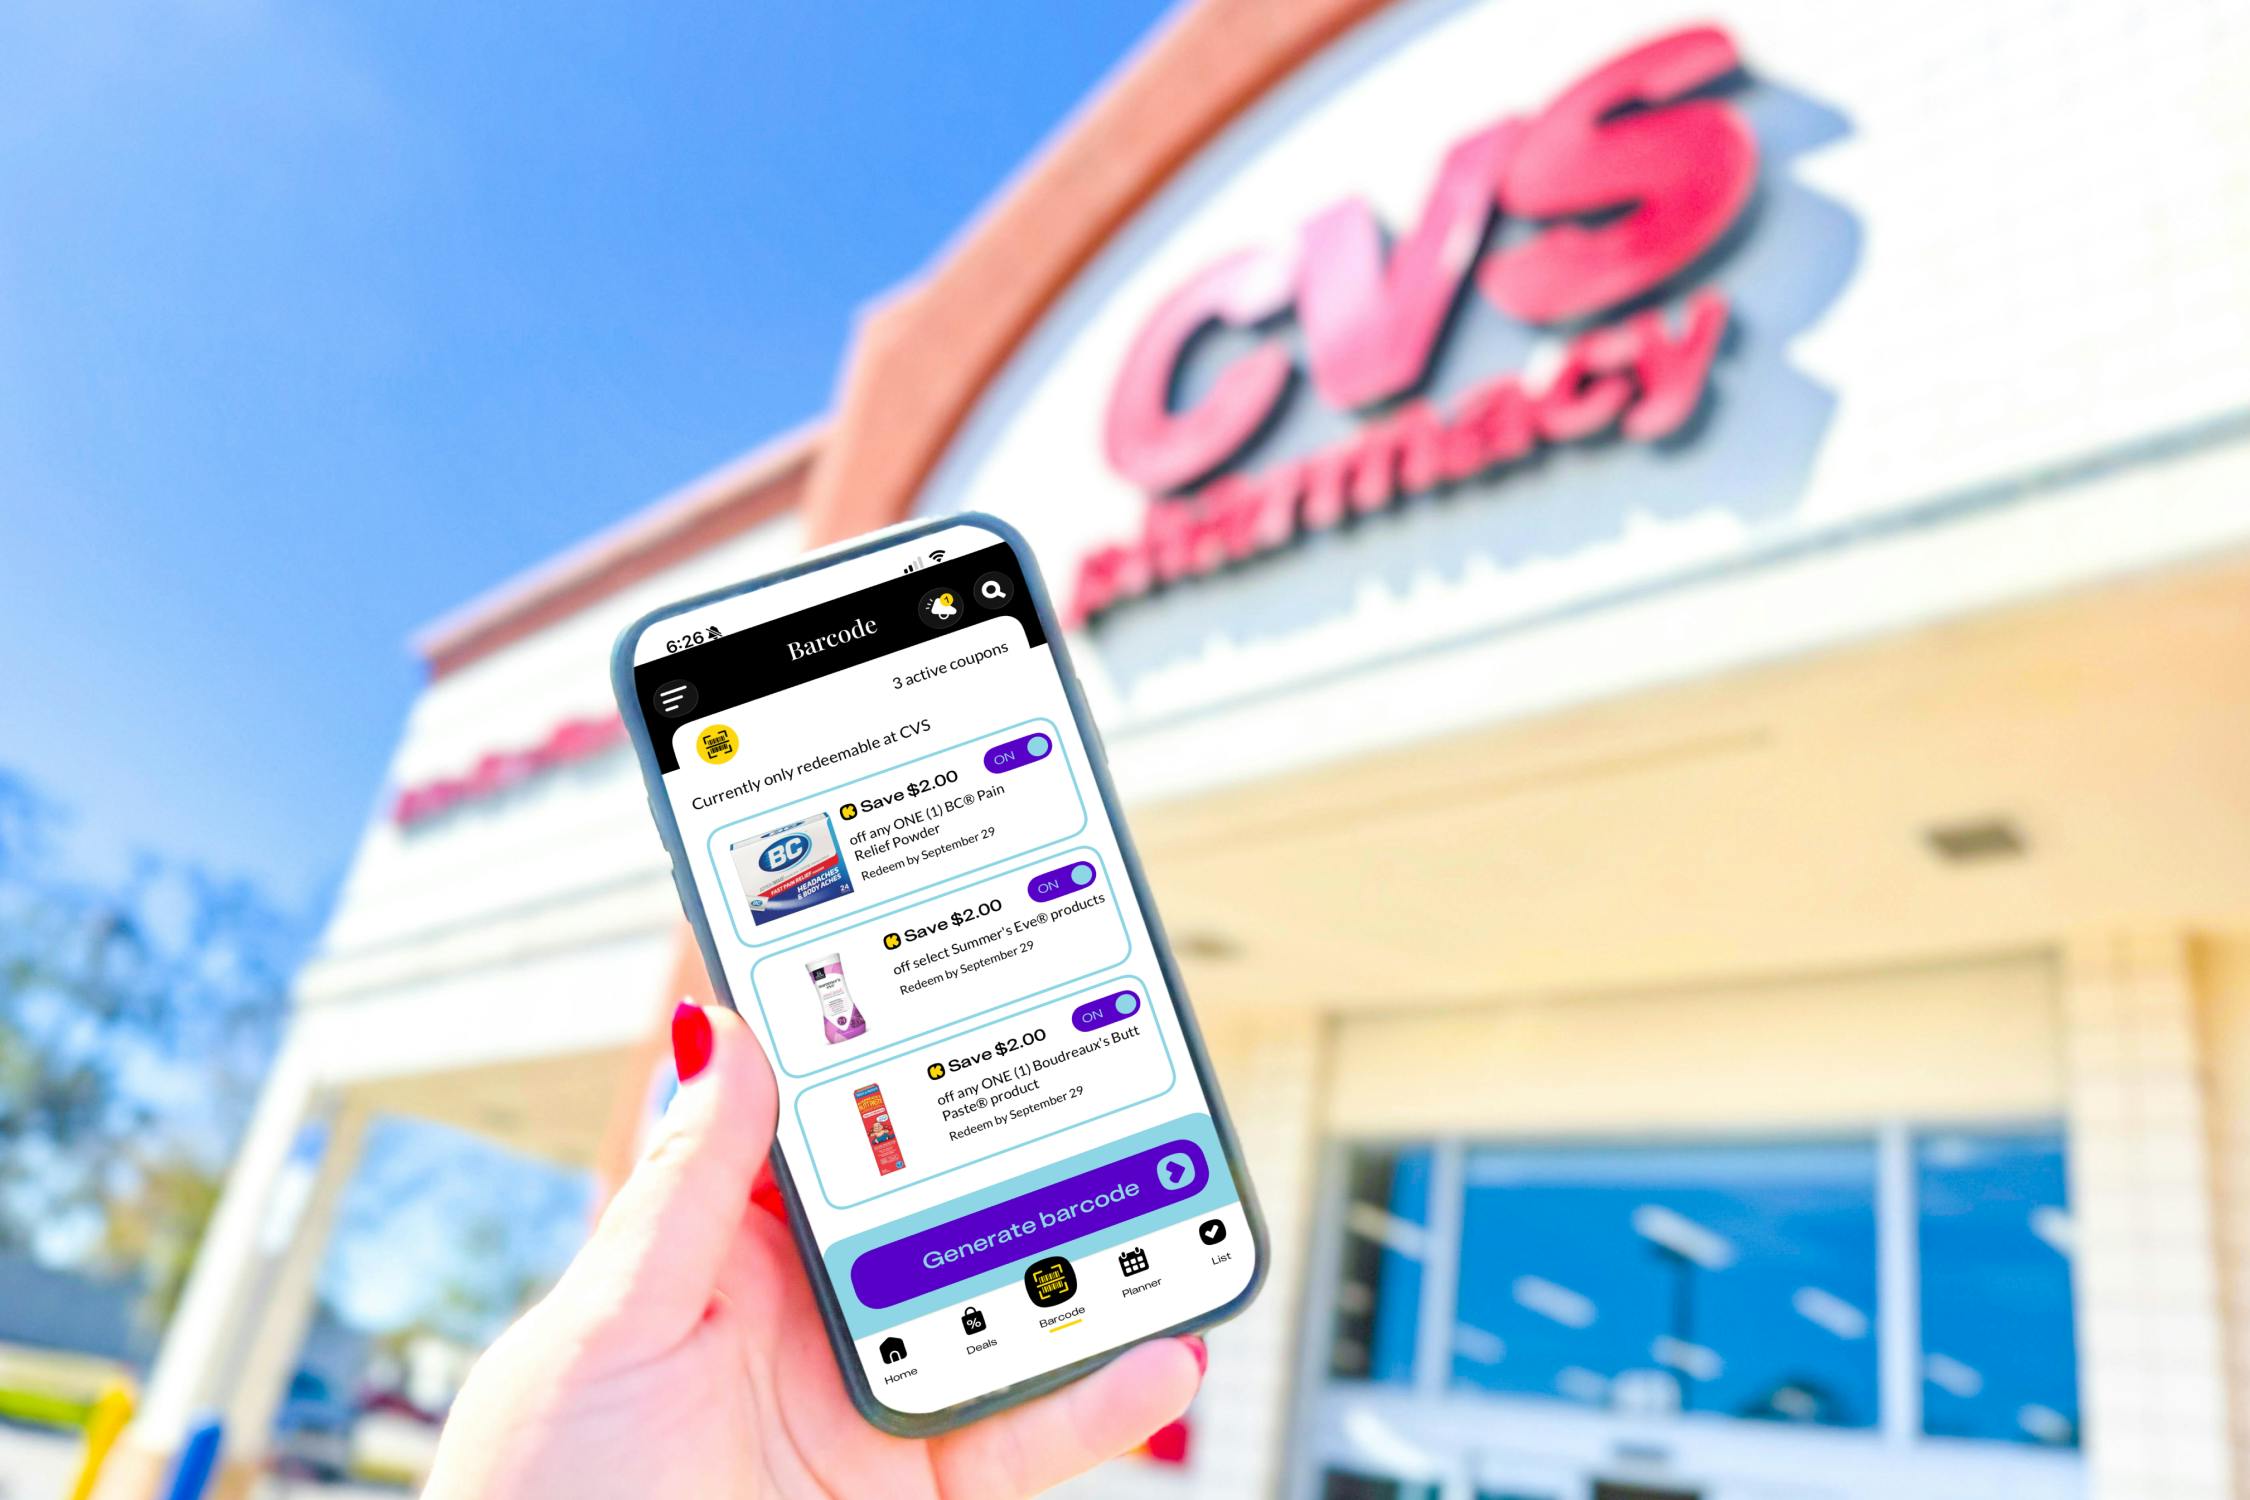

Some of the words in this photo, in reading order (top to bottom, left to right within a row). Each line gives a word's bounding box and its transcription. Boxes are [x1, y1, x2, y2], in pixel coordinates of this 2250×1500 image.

[1101, 24, 1758, 496] CVS
[665, 631, 705, 654] 6:26
[787, 618, 878, 661] Barcode
[892, 676, 903, 690] 3
[905, 664, 948, 686] active
[949, 643, 1009, 671] coupons
[691, 779, 761, 810] Currently
[764, 768, 794, 786] only
[796, 738, 881, 775] redeemable
[883, 731, 899, 746] at
[899, 718, 931, 739] CVS
[993, 750, 1015, 767] ON
[860, 791, 905, 813] Save
[906, 770, 959, 798] $2.00
[849, 830, 867, 846] off
[869, 824, 891, 839] any
[893, 810, 925, 830] ONE
[926, 804, 943, 821] (1)
[944, 795, 975, 813] BC®
[976, 785, 1005, 802] Pain
[767, 836, 804, 870] BC
[854, 839, 891, 862] Relief
[892, 825, 940, 849] Powder
[861, 860, 906, 881] Redeem
[905, 855, 920, 866] by
[921, 833, 979, 860] September
[980, 826, 995, 840] 29
[796, 866, 840, 893] HEADACHES
[802, 884, 821, 898] BODY
[820, 873, 842, 889] ACHES
[839, 883, 850, 892] 24
[1037, 878, 1059, 895] ON
[893, 959, 911, 975] off
[912, 947, 951, 969] select
[951, 926, 1013, 955] Summer's
[1013, 912, 1048, 933] Eve®
[1050, 894, 1106, 923] products
[903, 920, 949, 943] Save
[950, 898, 1002, 927] $2.00
[899, 974, 944, 996] Redeem
[944, 969, 959, 980] by
[959, 947, 1018, 974] September
[1020, 940, 1034, 954] 29
[1081, 1008, 1103, 1024] ON
[937, 1090, 955, 1106] off
[957, 1083, 979, 1100] any
[981, 1069, 1013, 1090] ONE
[1013, 1063, 1031, 1080] (1)
[1032, 1037, 1111, 1072] Boudreaux's
[1110, 1025, 1141, 1044] Butt
[948, 1050, 993, 1073] Save
[994, 1028, 1047, 1057] $2.00
[942, 1097, 988, 1122] Paste®
[990, 1079, 1040, 1107] product
[948, 1120, 994, 1142] Redeem
[994, 1114, 1008, 1126] by
[1009, 1093, 1068, 1120] September
[1068, 1085, 1084, 1099] 29
[922, 1220, 1037, 1269] Generate
[1038, 1183, 1140, 1229] barcode
[1211, 1252, 1232, 1265] List
[1121, 1278, 1162, 1298] Planner
[1039, 1306, 1086, 1329] Barcode
[966, 1339, 998, 1355] Deals
[884, 1368, 918, 1385] Home
